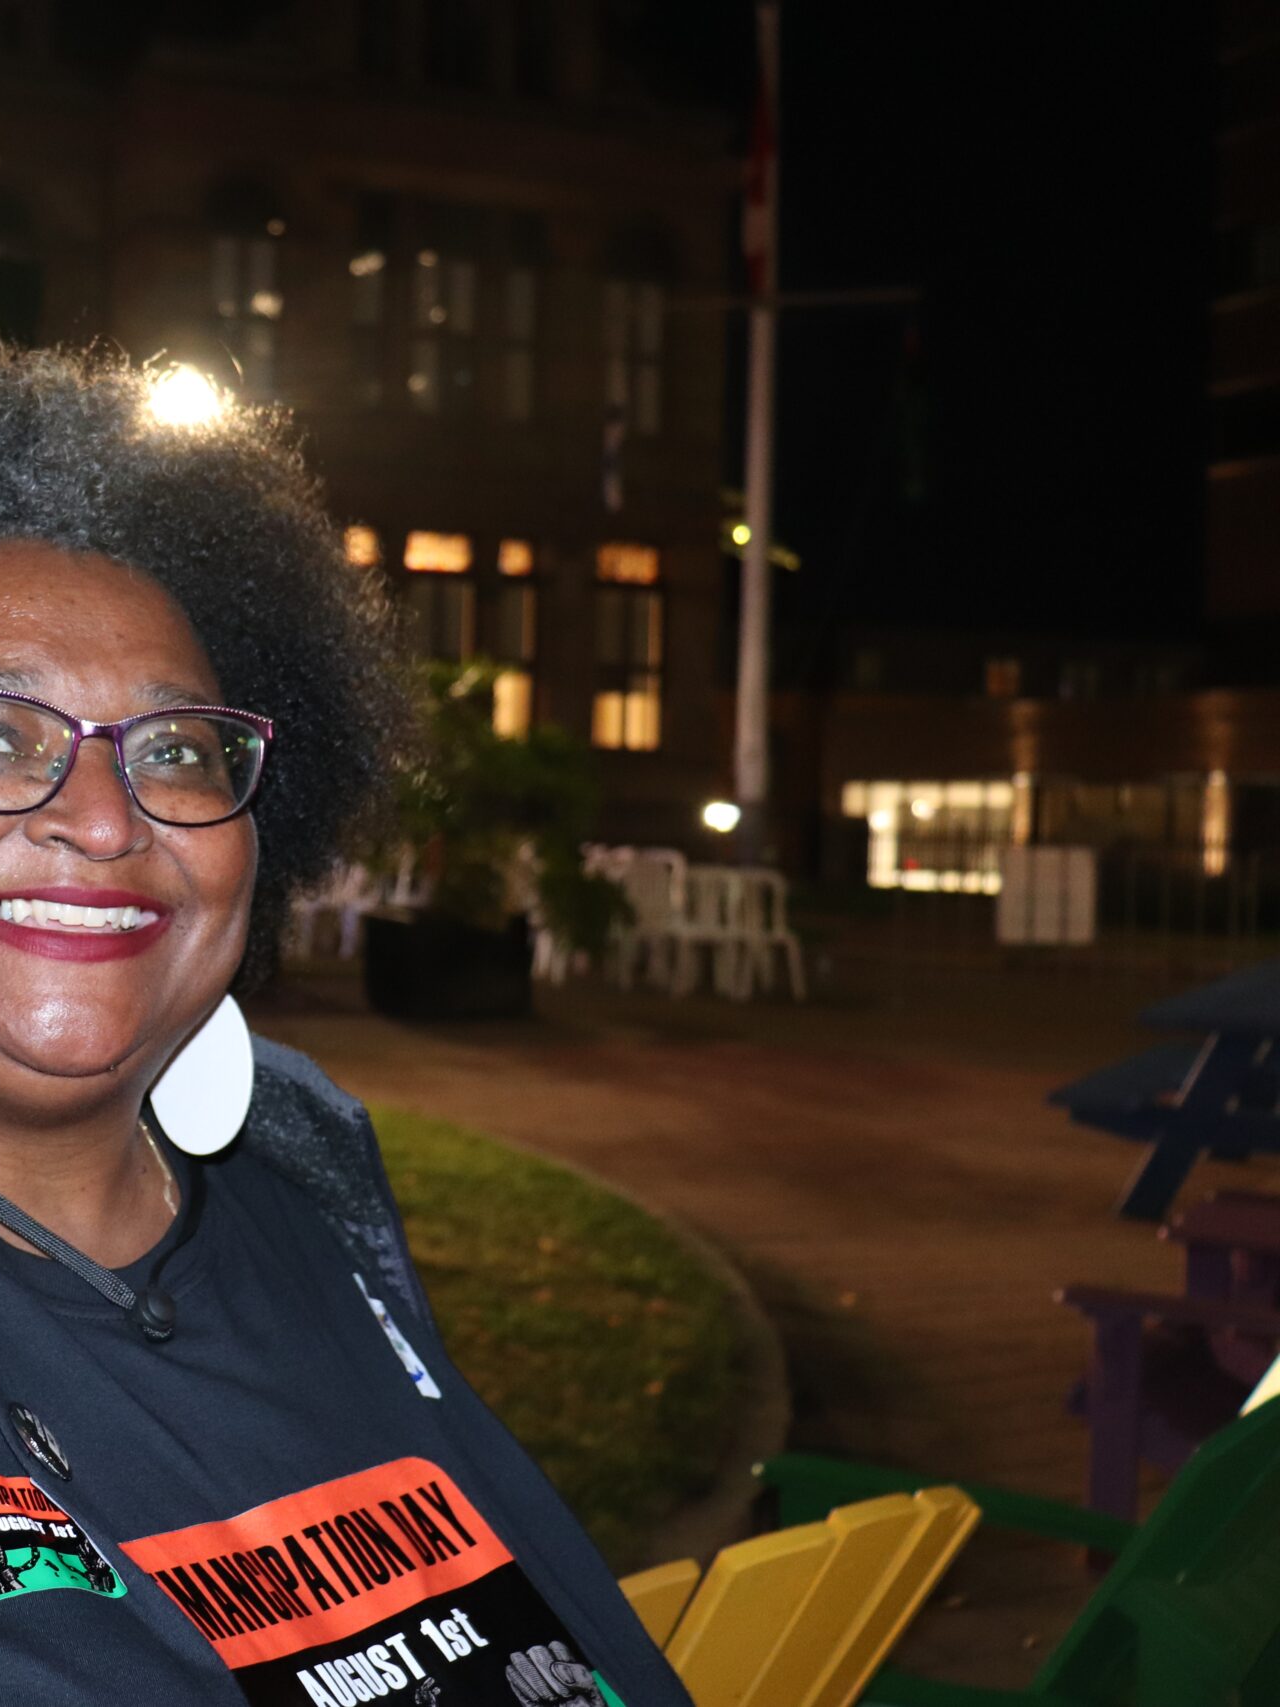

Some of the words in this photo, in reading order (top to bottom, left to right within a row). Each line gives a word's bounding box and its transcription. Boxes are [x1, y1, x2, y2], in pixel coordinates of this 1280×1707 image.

[49, 1523, 78, 1538] 1st
[149, 1507, 416, 1641] MANCIPATION
[378, 1481, 477, 1567] DAY
[296, 1632, 426, 1707] AUGUST
[420, 1608, 489, 1662] 1st
